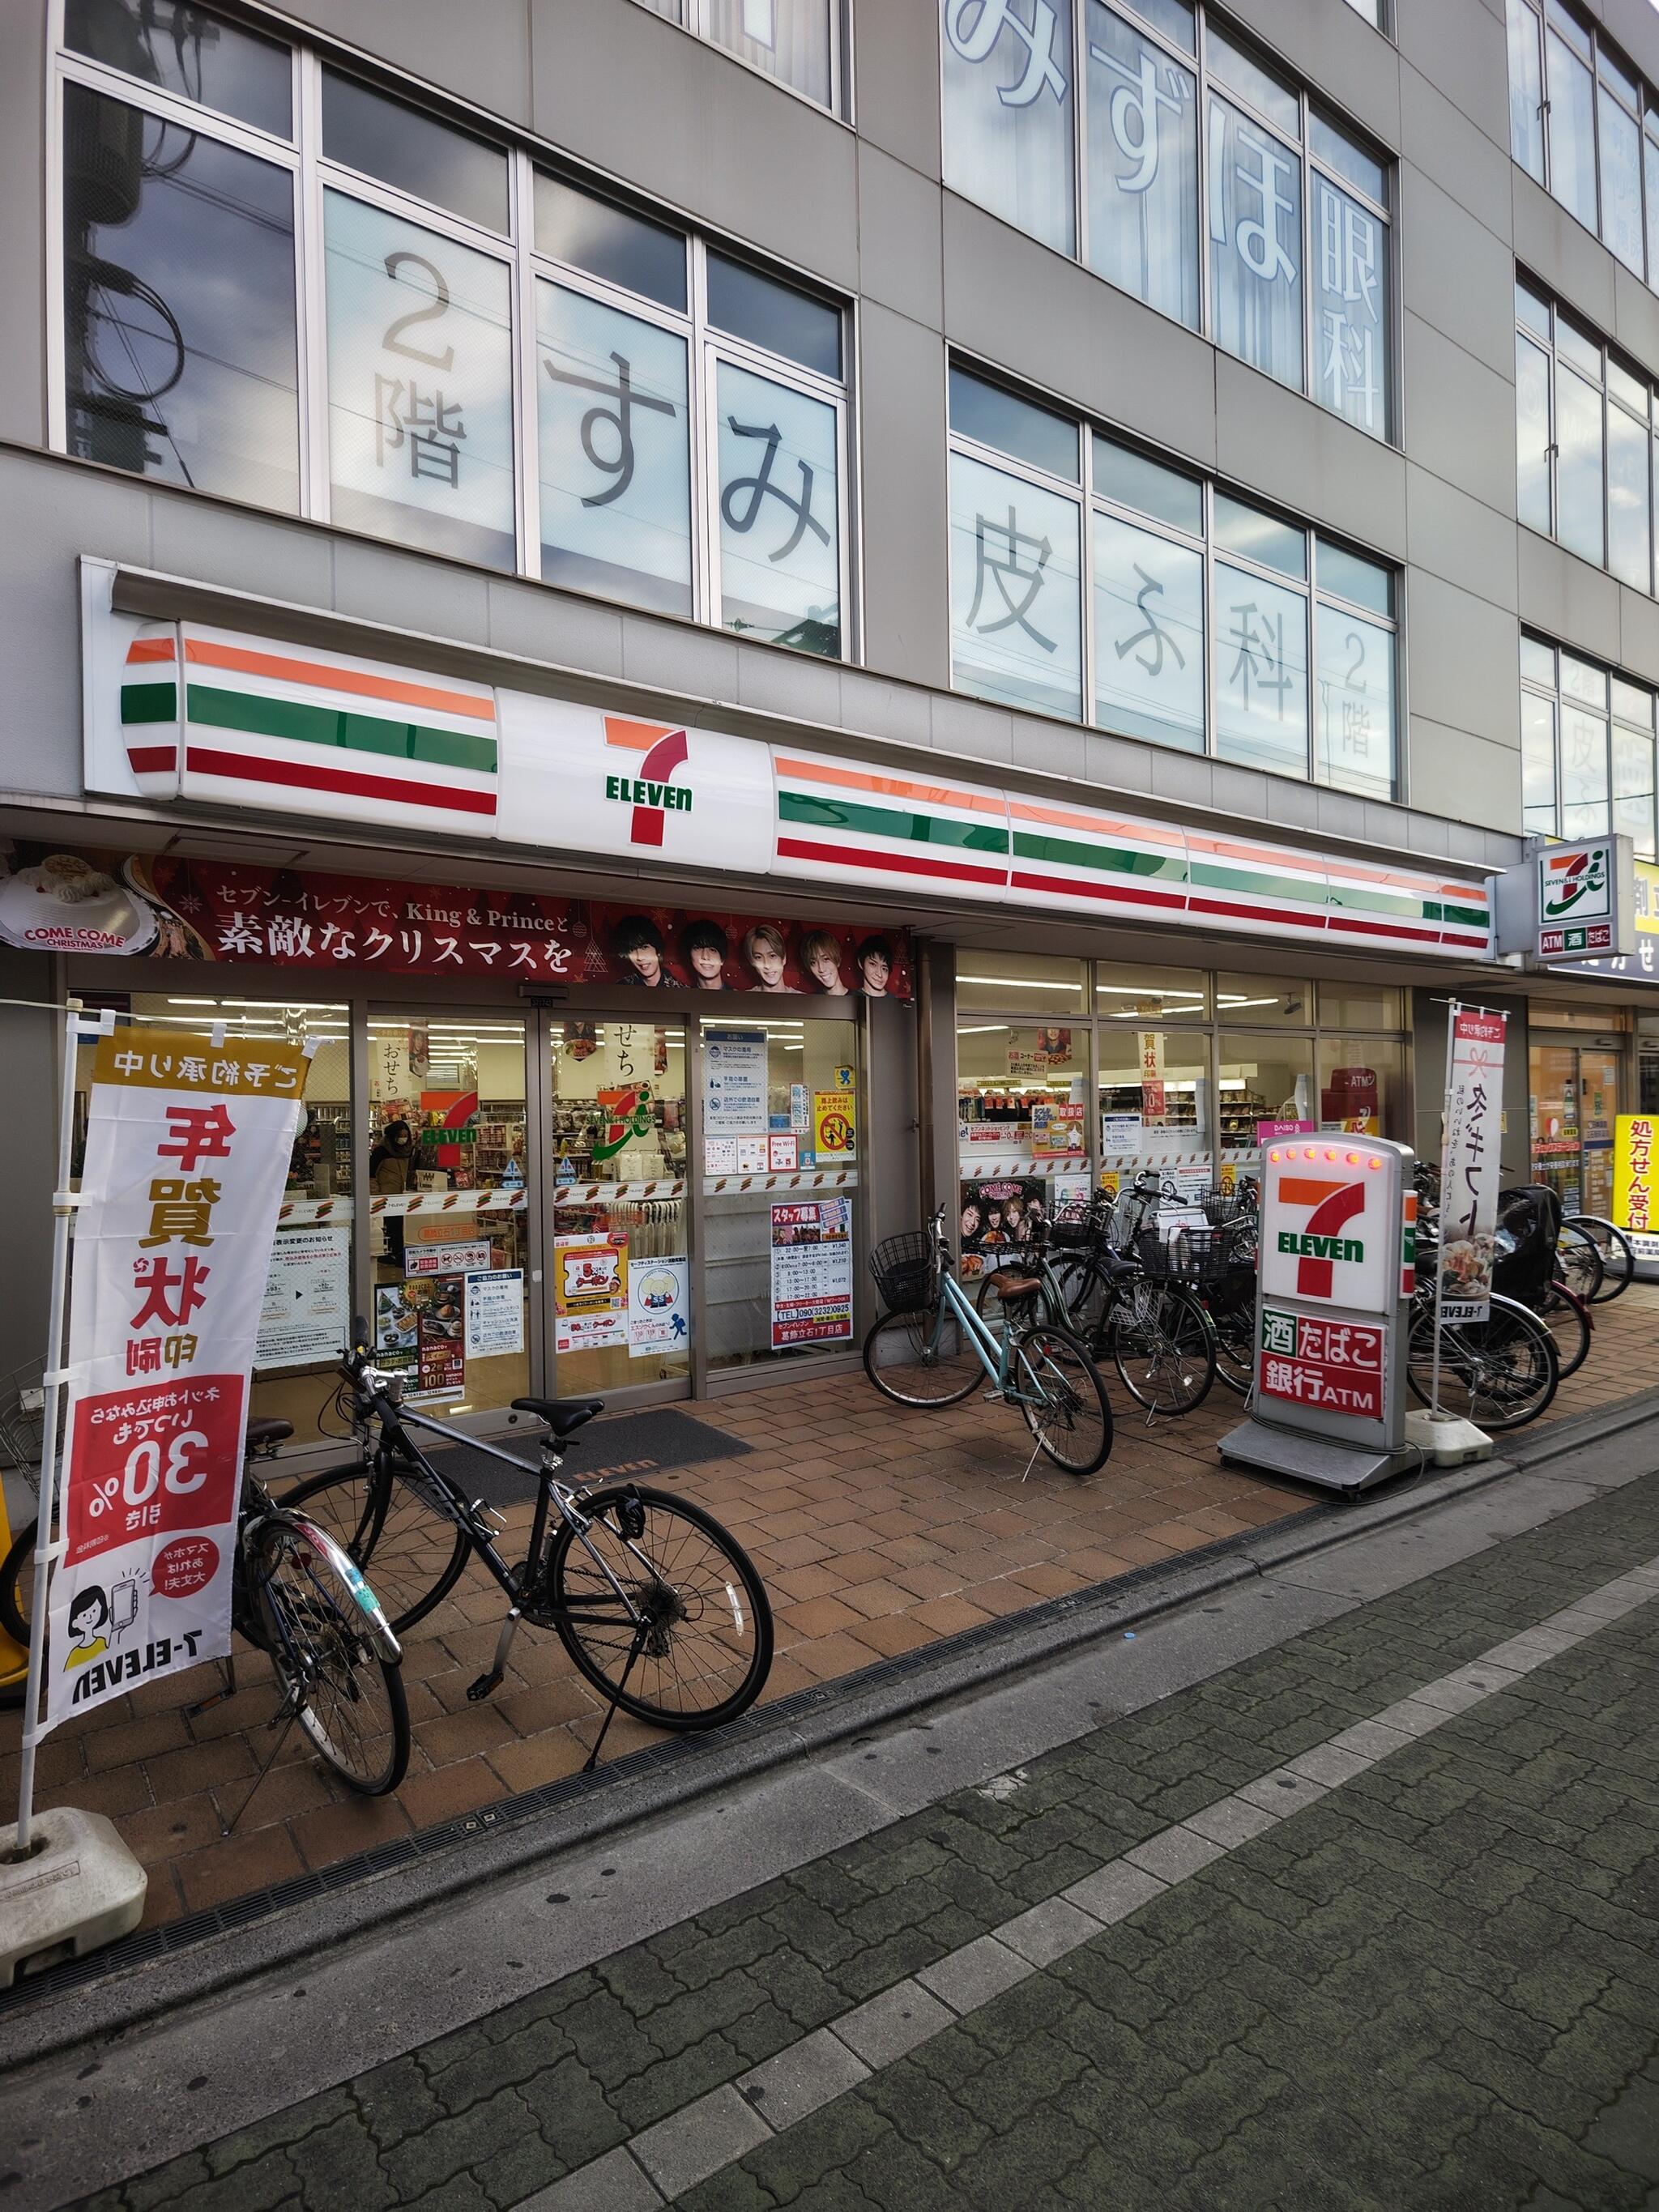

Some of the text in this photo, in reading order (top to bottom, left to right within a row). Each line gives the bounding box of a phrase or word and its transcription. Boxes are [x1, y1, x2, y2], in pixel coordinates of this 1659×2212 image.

[1319, 181, 1381, 431] 眼科
[374, 252, 465, 489] 2階
[543, 351, 831, 562] すみ
[966, 505, 1293, 722] 皮ふ科
[1342, 633, 1371, 758] 2階
[1572, 872, 1606, 882] HOLDINGS
[406, 902, 462, 927] King
[467, 908, 483, 925] &
[24, 927, 125, 948] COME COME
[47, 938, 104, 949] CHRISTMAS
[215, 911, 573, 973] 素敵なクリスマスを
[1542, 935, 1563, 948] ATM
[1568, 932, 1582, 947] 酒
[1588, 930, 1610, 944] たばこ
[614, 1025, 638, 1077] せち
[383, 1043, 401, 1095] おせち
[1351, 1076, 1368, 1088] ATM
[817, 1104, 853, 1112] 止めてください
[1059, 1106, 1084, 1118] 取扱店
[620, 1115, 656, 1124] HOLDINGS
[1627, 1119, 1653, 1232] 処方せん受付
[979, 1183, 1023, 1196] COME COME
[774, 1205, 817, 1223] スタッフ募集
[273, 1236, 333, 1247] 表示変更のお知らせ
[477, 1273, 513, 1281] ご協力のお願い
[576, 1275, 609, 1288] クーポン
[781, 1324, 842, 1341] 葛飾立石1丁目店
[1264, 1313, 1378, 1368] 酒 たばこ
[422, 1373, 444, 1387] 100
